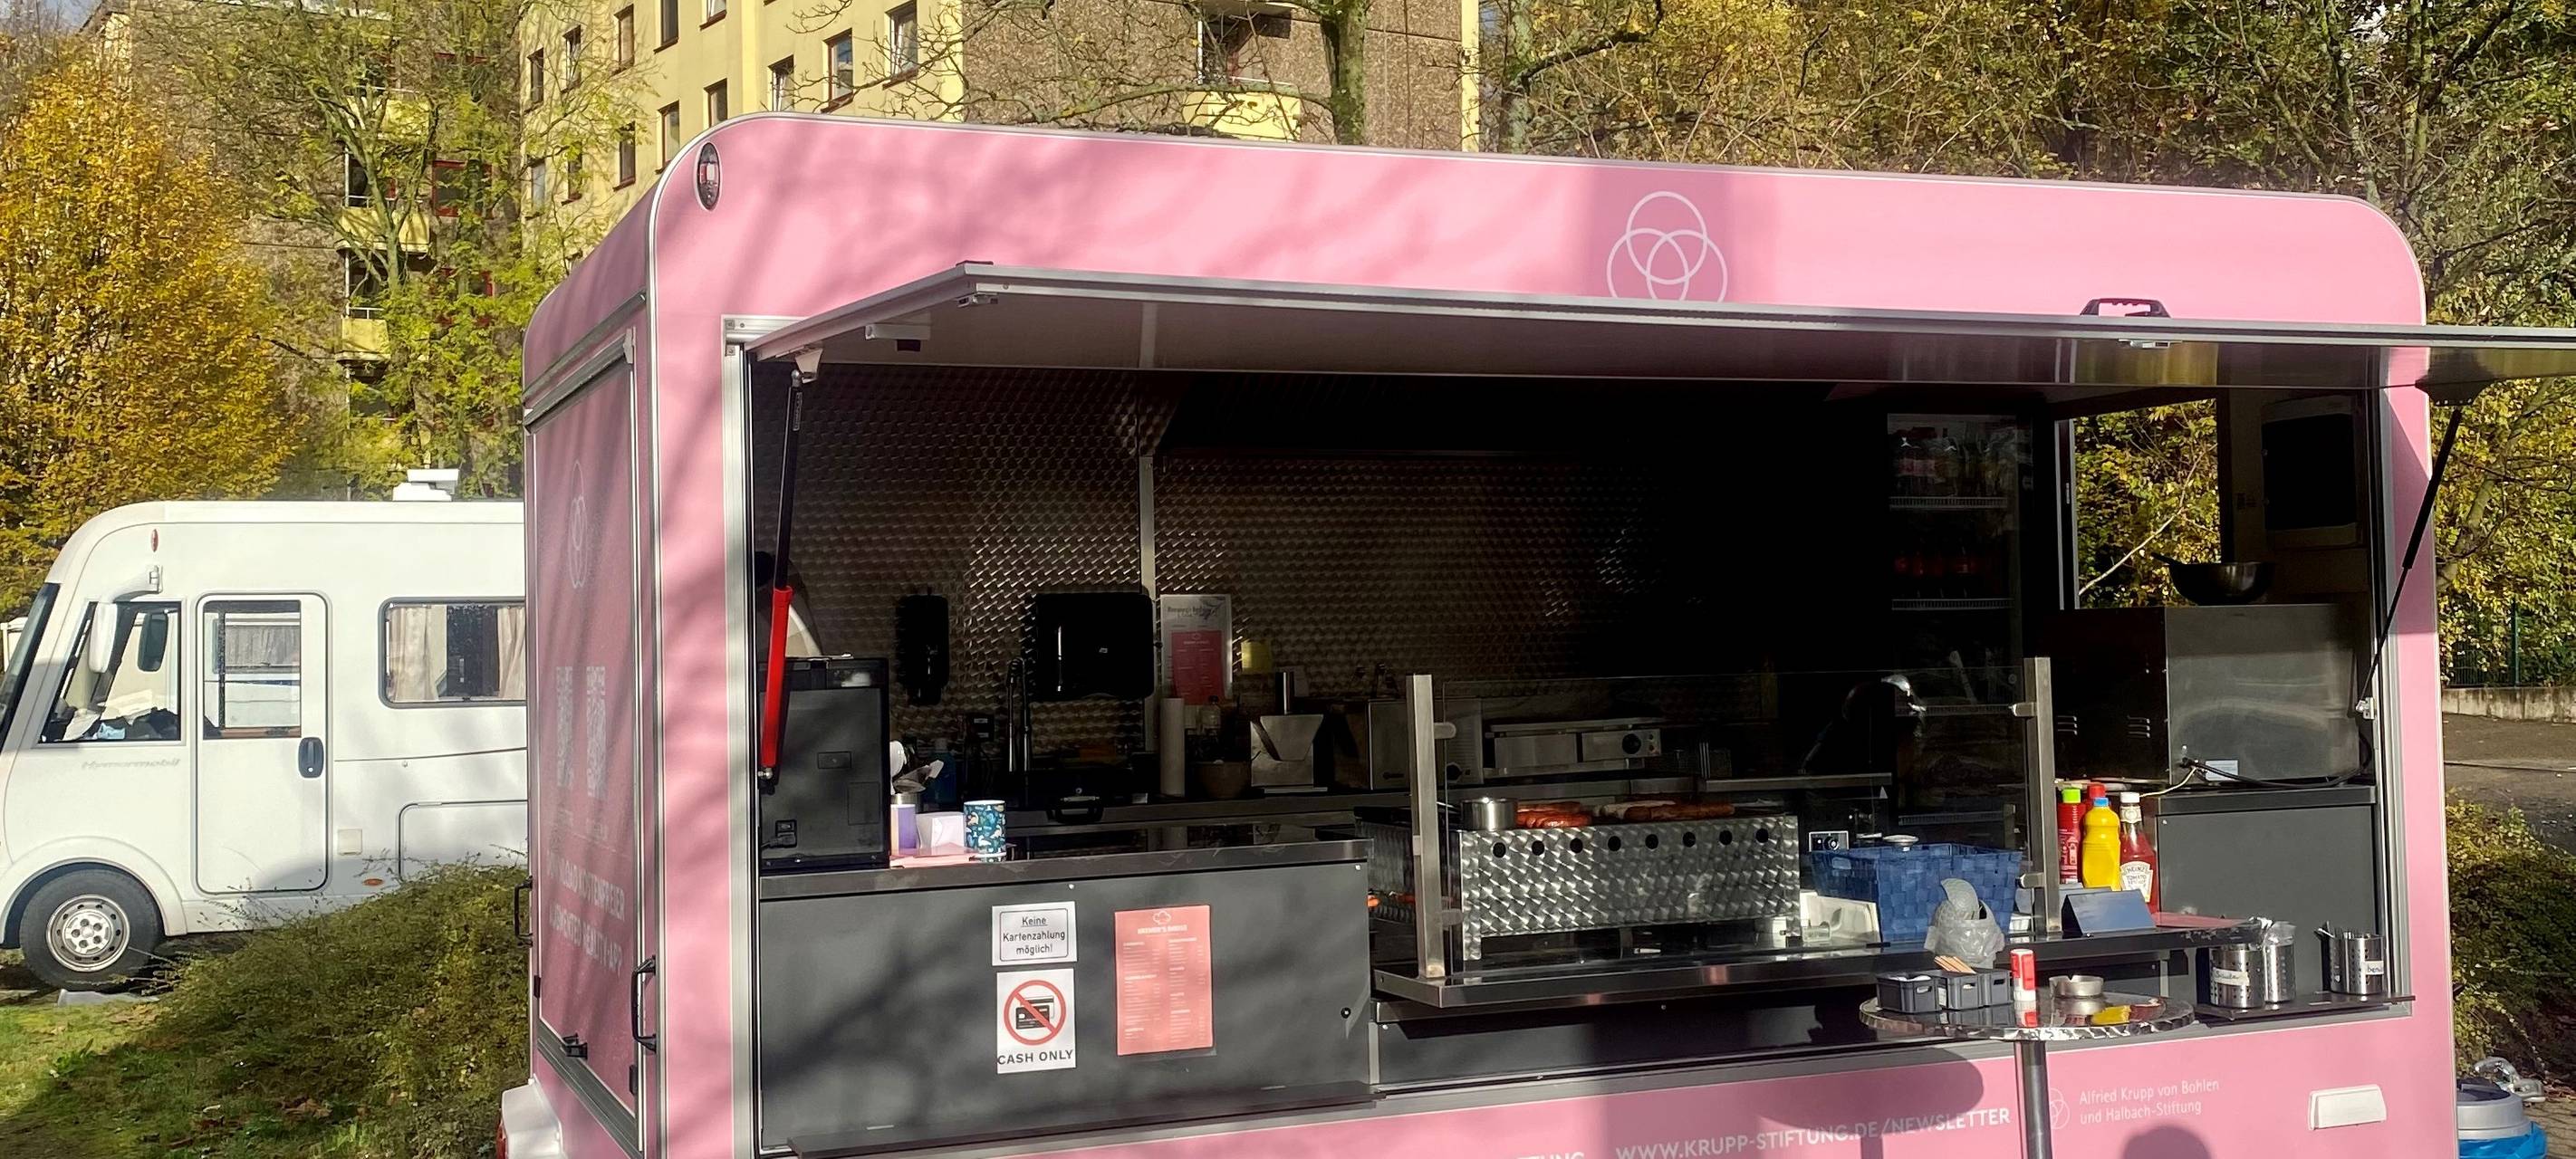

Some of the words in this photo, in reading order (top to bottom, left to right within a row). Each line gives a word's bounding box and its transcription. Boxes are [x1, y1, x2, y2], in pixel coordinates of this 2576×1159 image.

[1022, 916, 1047, 925] Keine
[1003, 931, 1065, 942] Kartenzahlung
[1015, 943, 1053, 955] möglich!
[996, 1052, 1033, 1065] CASH
[1039, 1049, 1073, 1061] ONLY
[2080, 1088, 2118, 1105] Alfried
[2120, 1087, 2154, 1102] Krupp
[2158, 1085, 2178, 1097] von
[2181, 1079, 2220, 1095] Bohlen
[2080, 1111, 2102, 1125] und
[2106, 1101, 2202, 1123] Halbach-Stiftung
